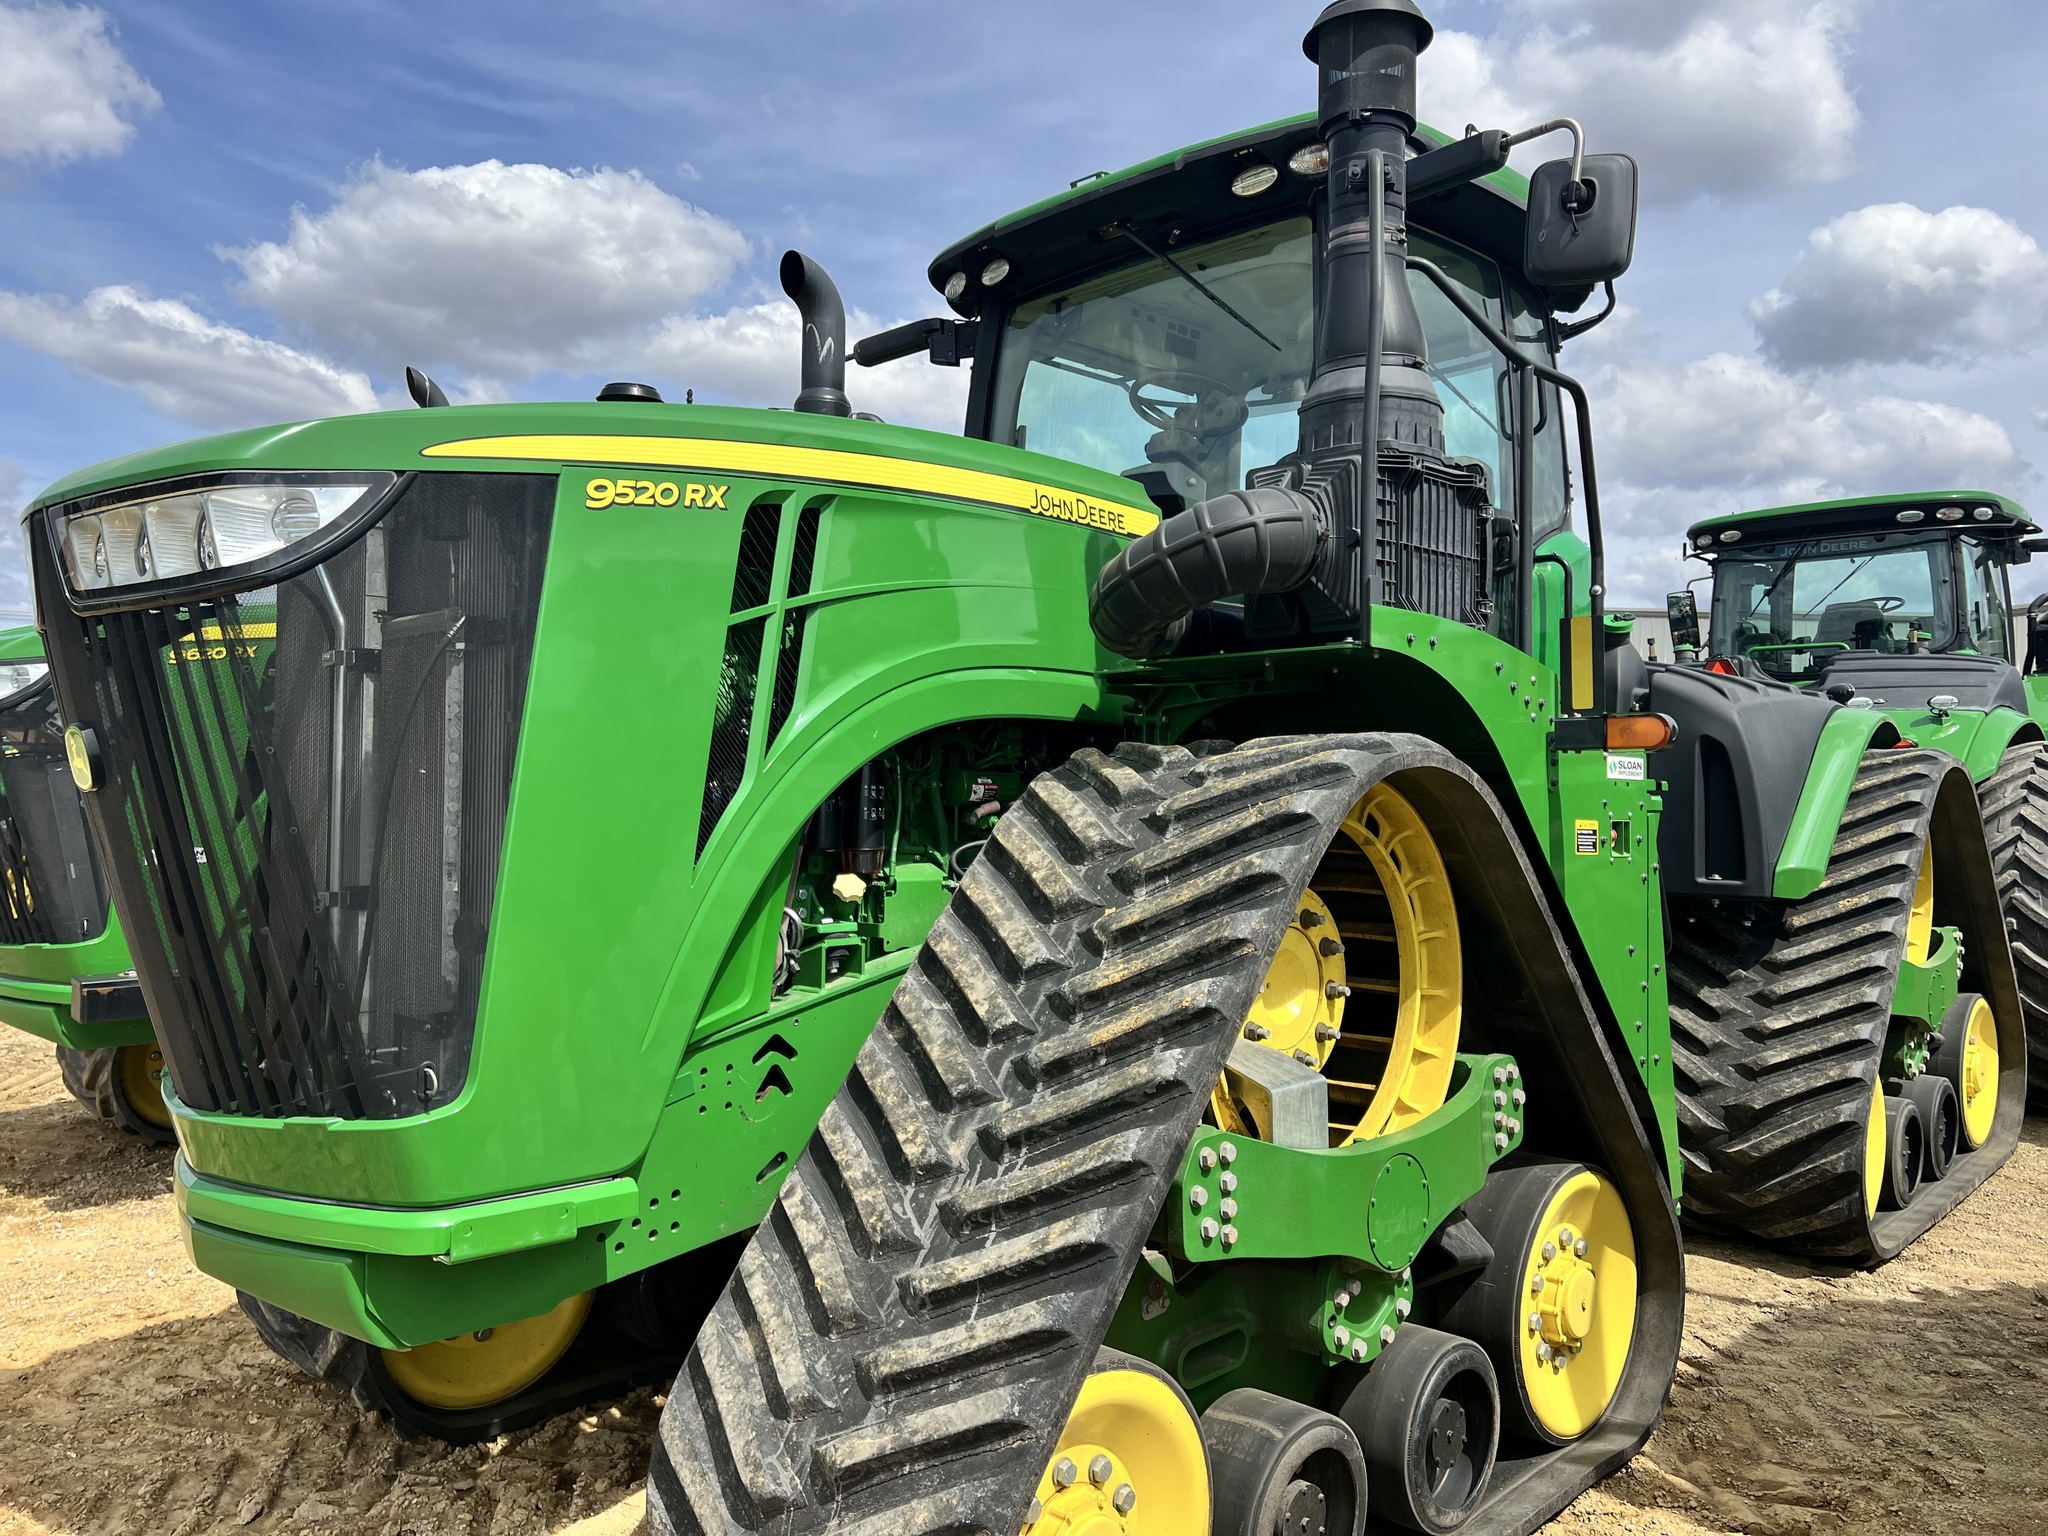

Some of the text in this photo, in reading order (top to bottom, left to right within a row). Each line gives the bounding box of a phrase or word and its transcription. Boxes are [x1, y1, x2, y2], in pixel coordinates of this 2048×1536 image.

[585, 478, 731, 510] 9520 RX
[1030, 488, 1126, 531] JOHN DEERE
[1820, 541, 1868, 553] DEERE
[1618, 760, 1642, 770] SLOAN
